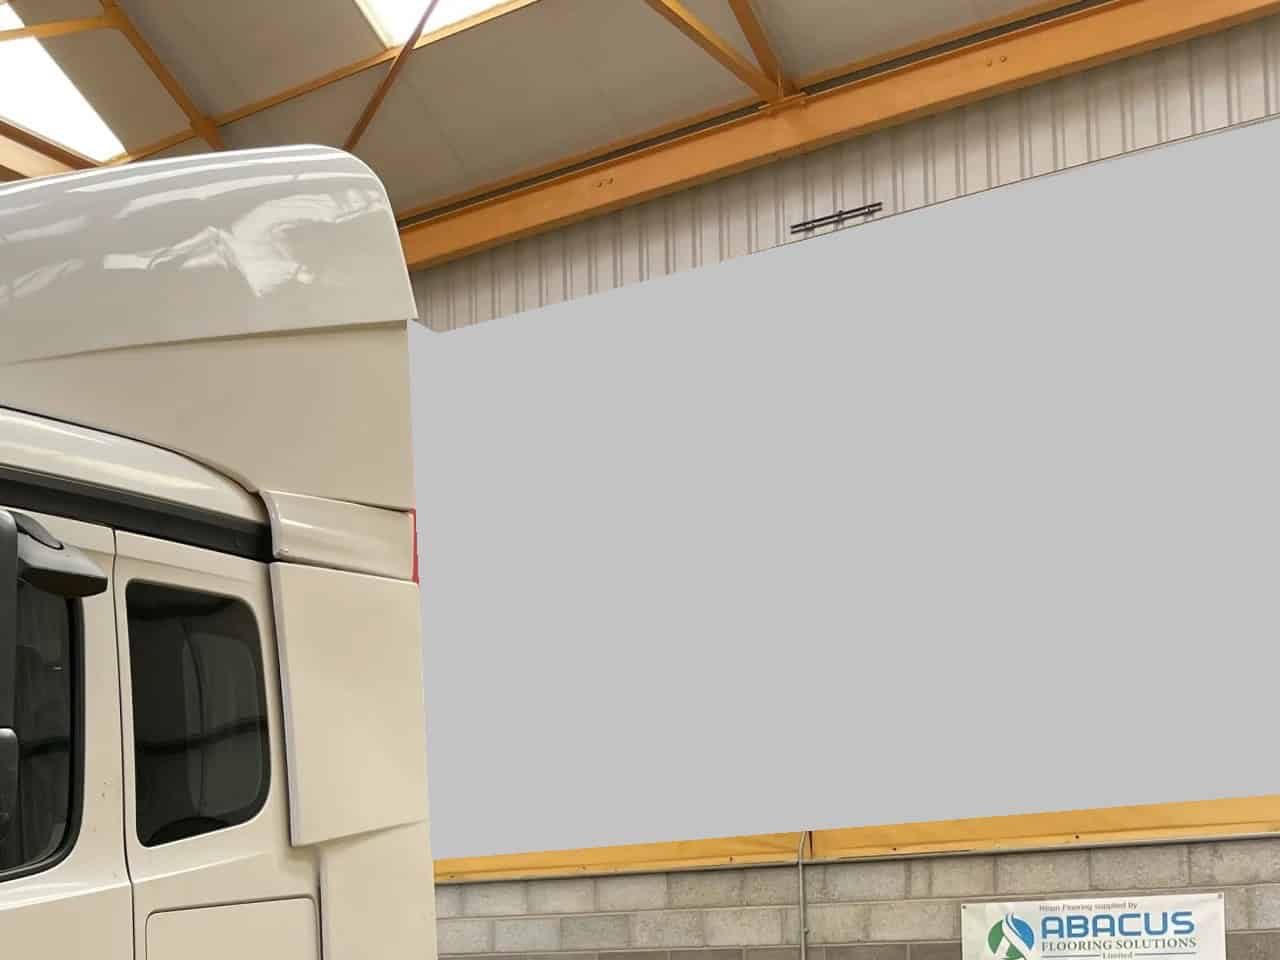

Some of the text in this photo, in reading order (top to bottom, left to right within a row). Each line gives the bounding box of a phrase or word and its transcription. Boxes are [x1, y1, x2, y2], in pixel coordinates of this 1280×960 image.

[1040, 911, 1195, 939] ABACUS
[1041, 936, 1197, 953] FLOORING SOLUTIONS
